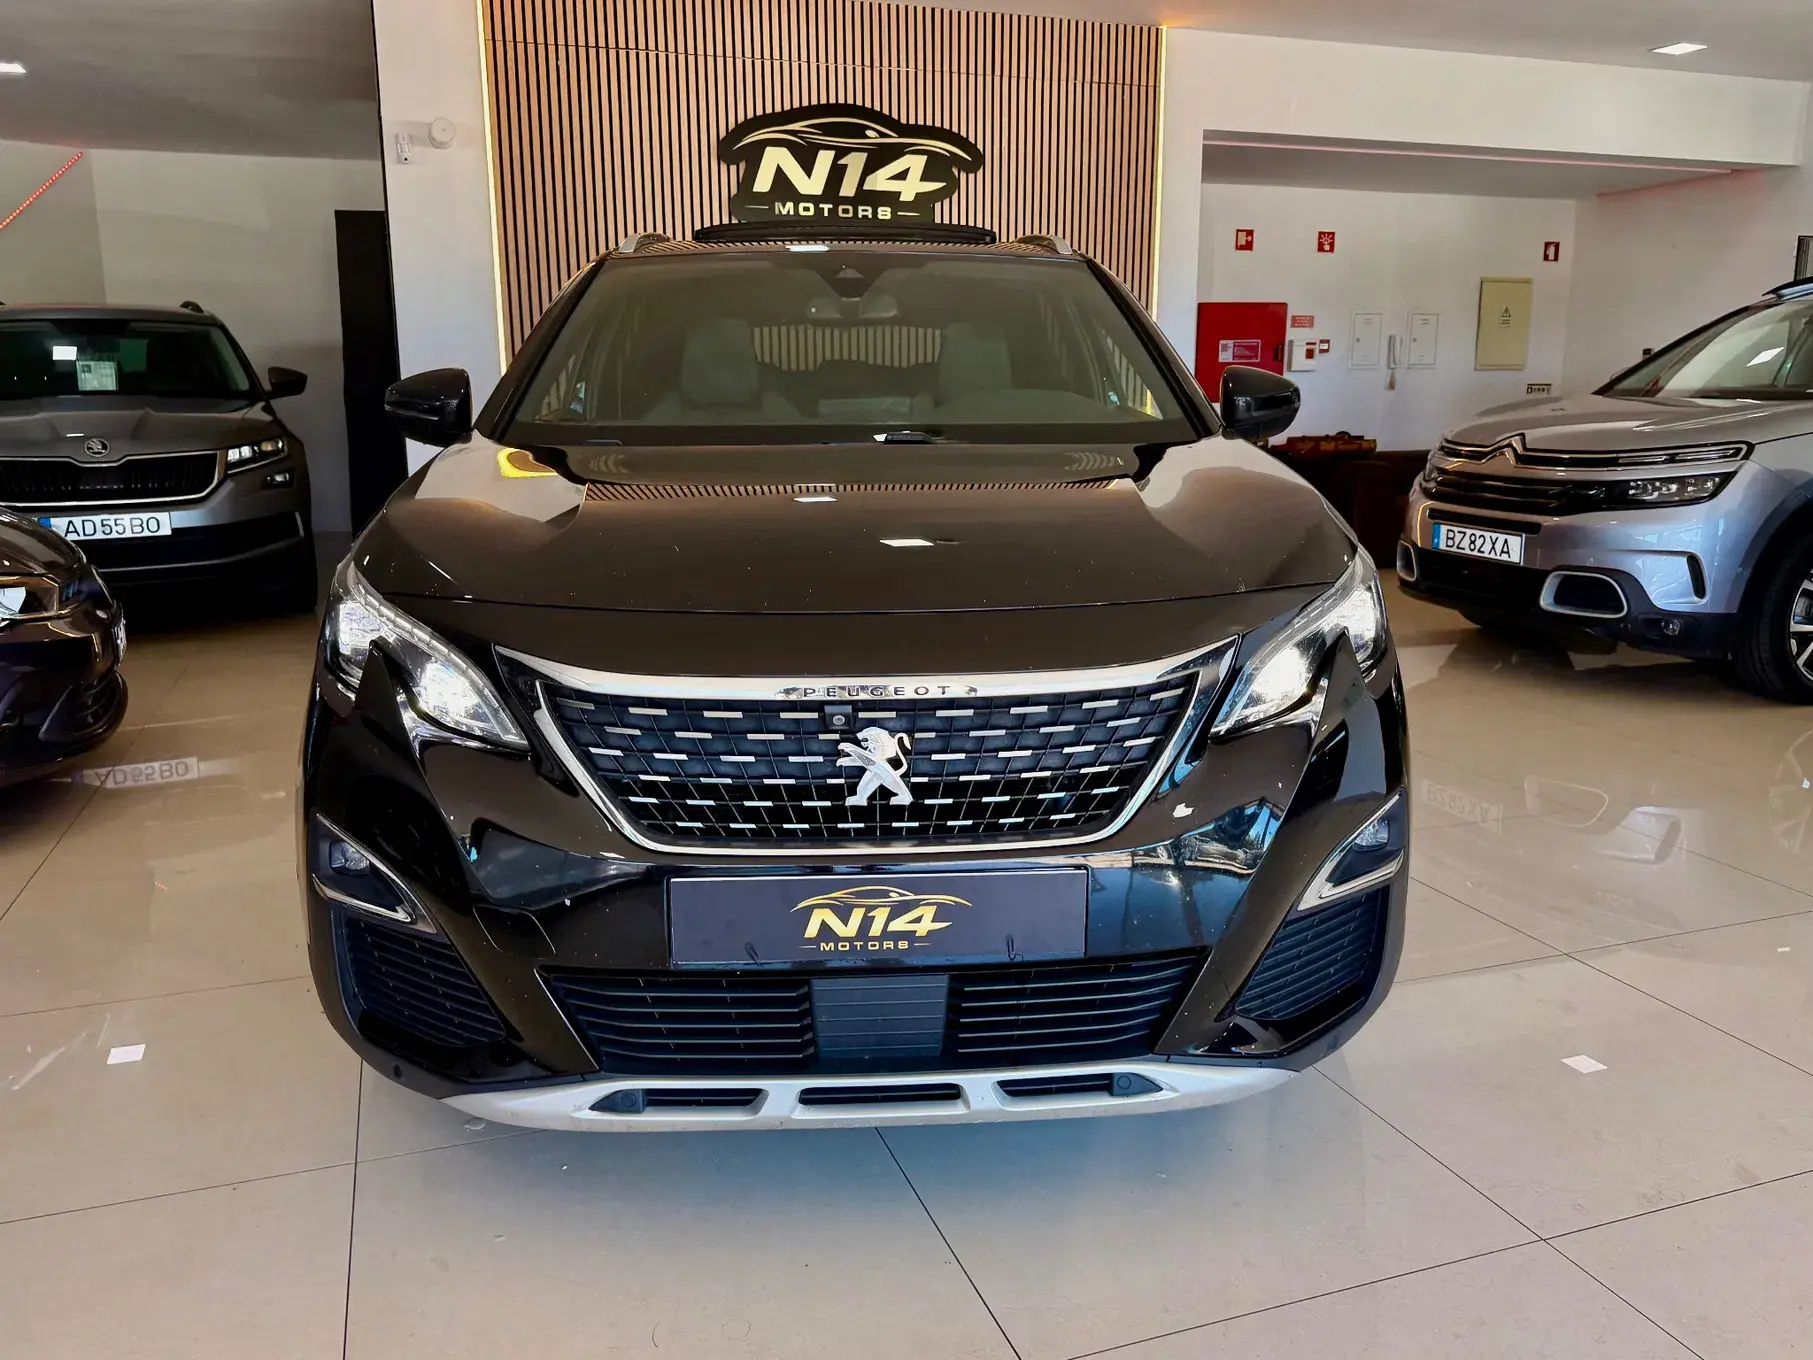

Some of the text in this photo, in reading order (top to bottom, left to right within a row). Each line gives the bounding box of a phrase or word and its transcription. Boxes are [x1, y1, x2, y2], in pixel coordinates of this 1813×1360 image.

[752, 146, 947, 202] N14
[774, 201, 892, 220] MOTORS
[803, 685, 951, 697] PEUGEOT
[803, 905, 952, 939] N14
[820, 940, 909, 952] MOTORS
